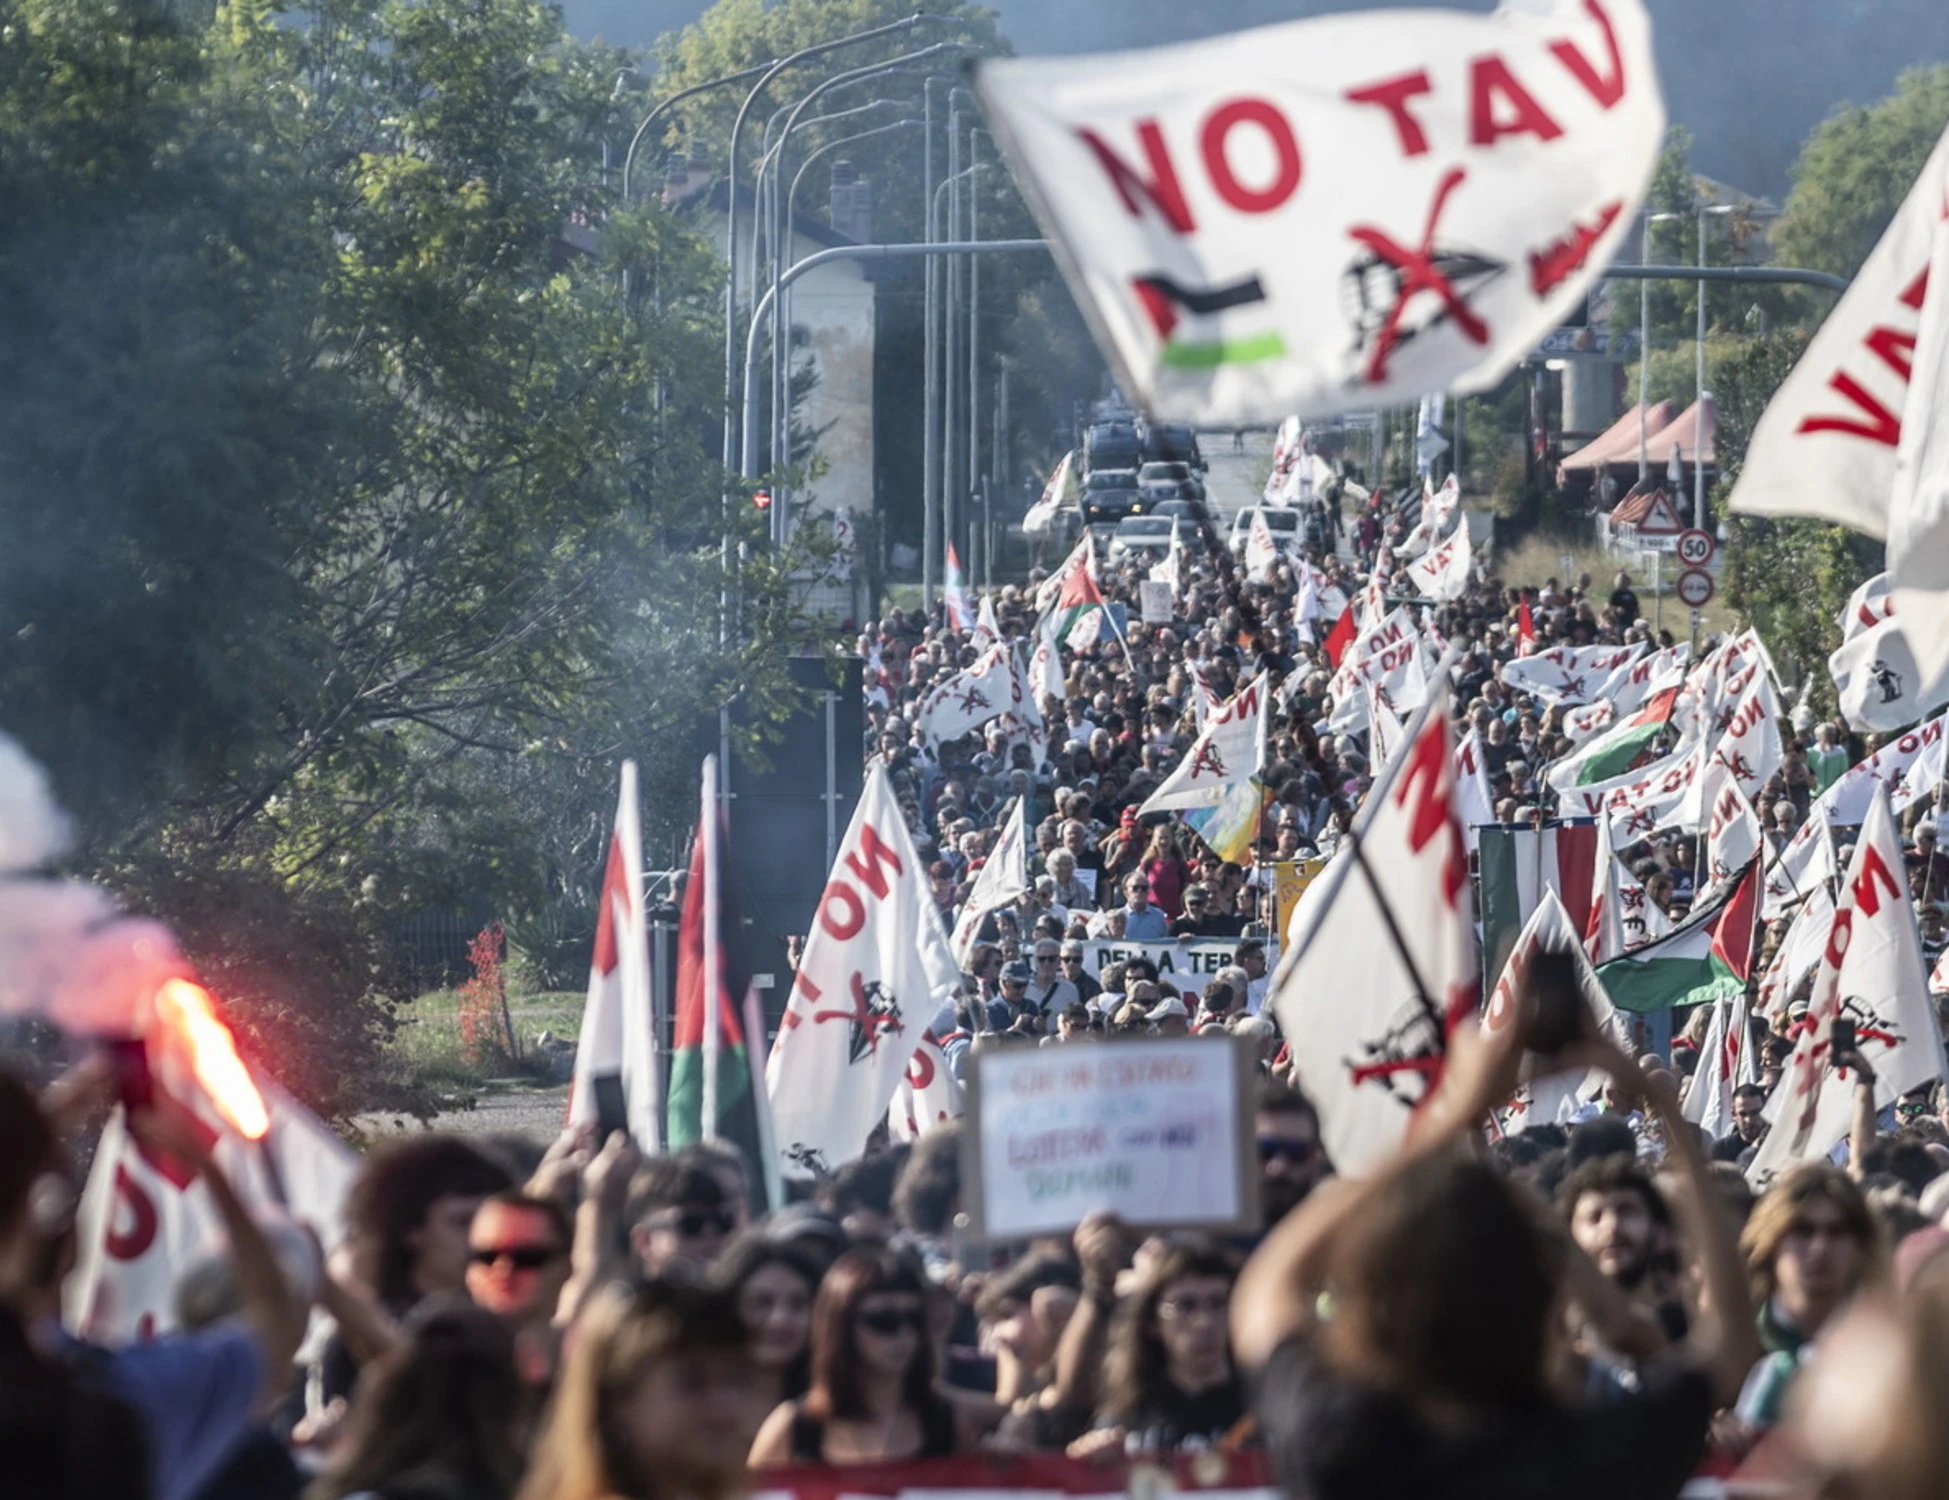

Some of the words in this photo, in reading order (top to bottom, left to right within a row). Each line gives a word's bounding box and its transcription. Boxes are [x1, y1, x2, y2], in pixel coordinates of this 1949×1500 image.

[1077, 96, 1303, 236] NO
[1343, 0, 1626, 158] TAV
[1684, 539, 1706, 558] 50
